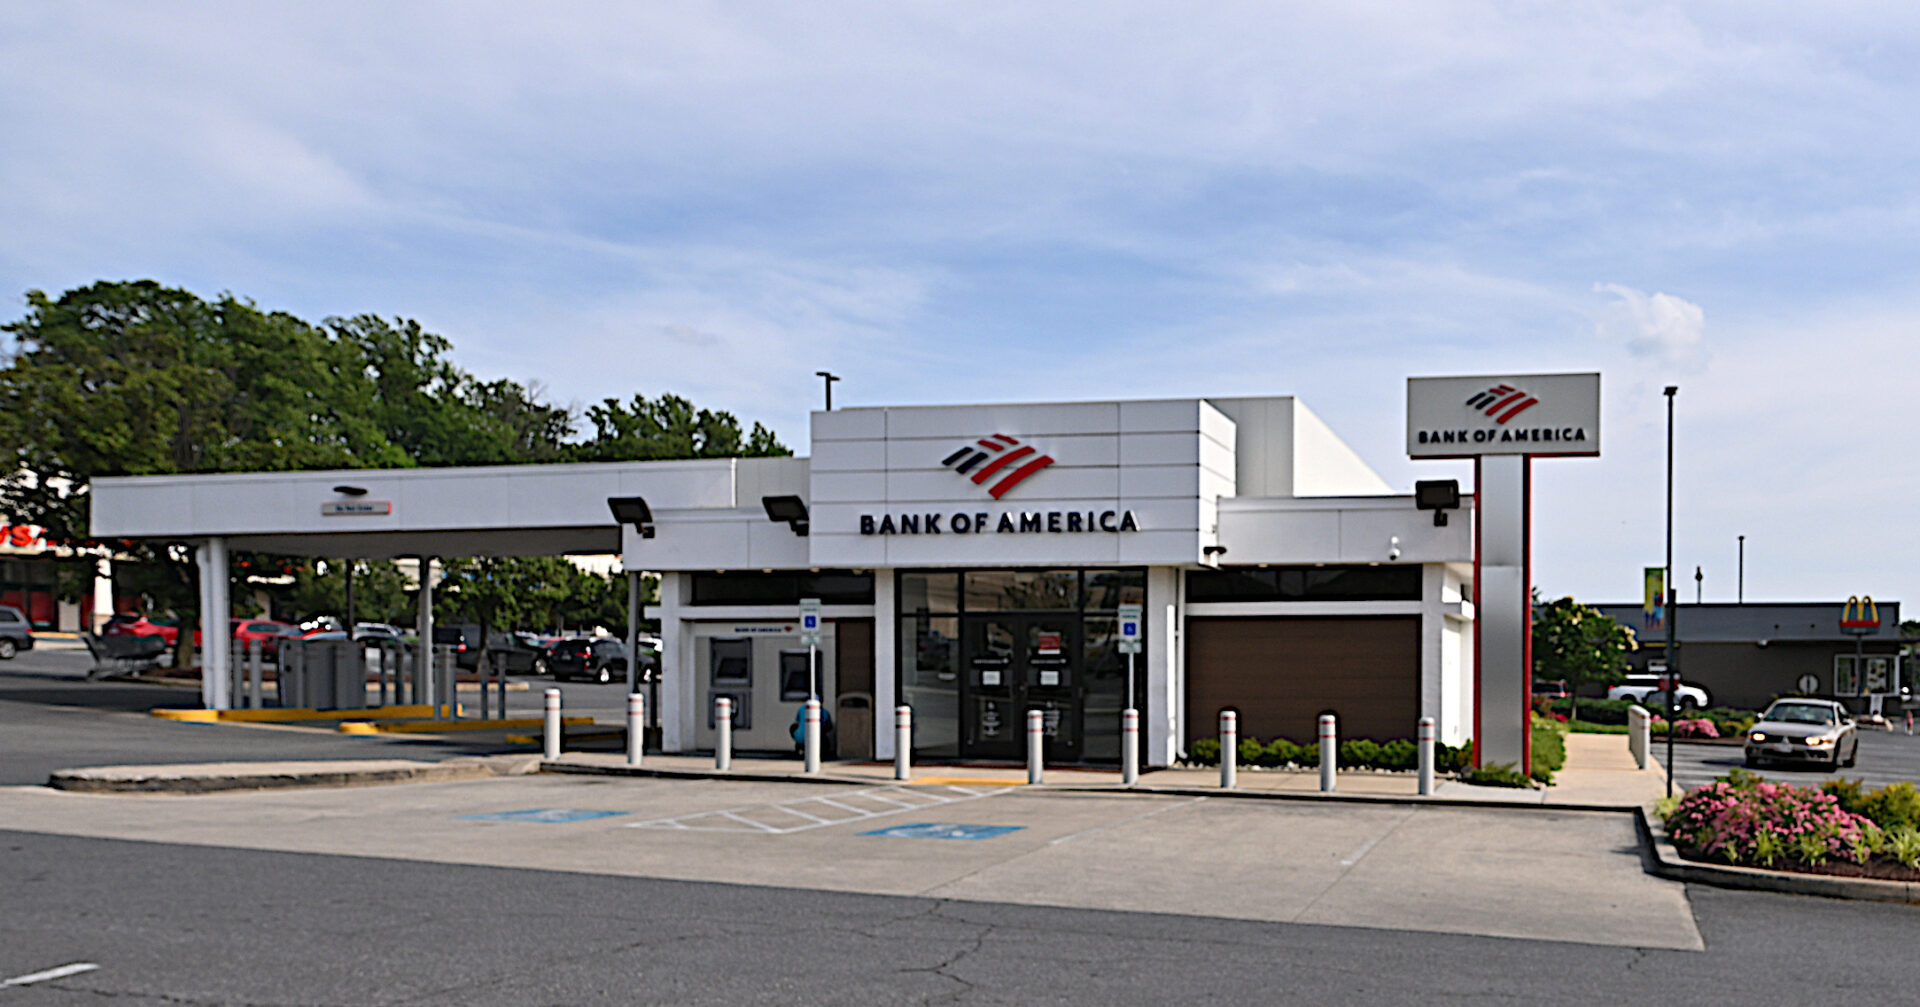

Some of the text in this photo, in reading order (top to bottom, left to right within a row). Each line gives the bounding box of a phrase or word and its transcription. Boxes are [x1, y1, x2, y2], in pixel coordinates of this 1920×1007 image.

[1418, 428, 1586, 444] BANK OF AMERICA
[860, 510, 1141, 535] BANK OF AMERICA
